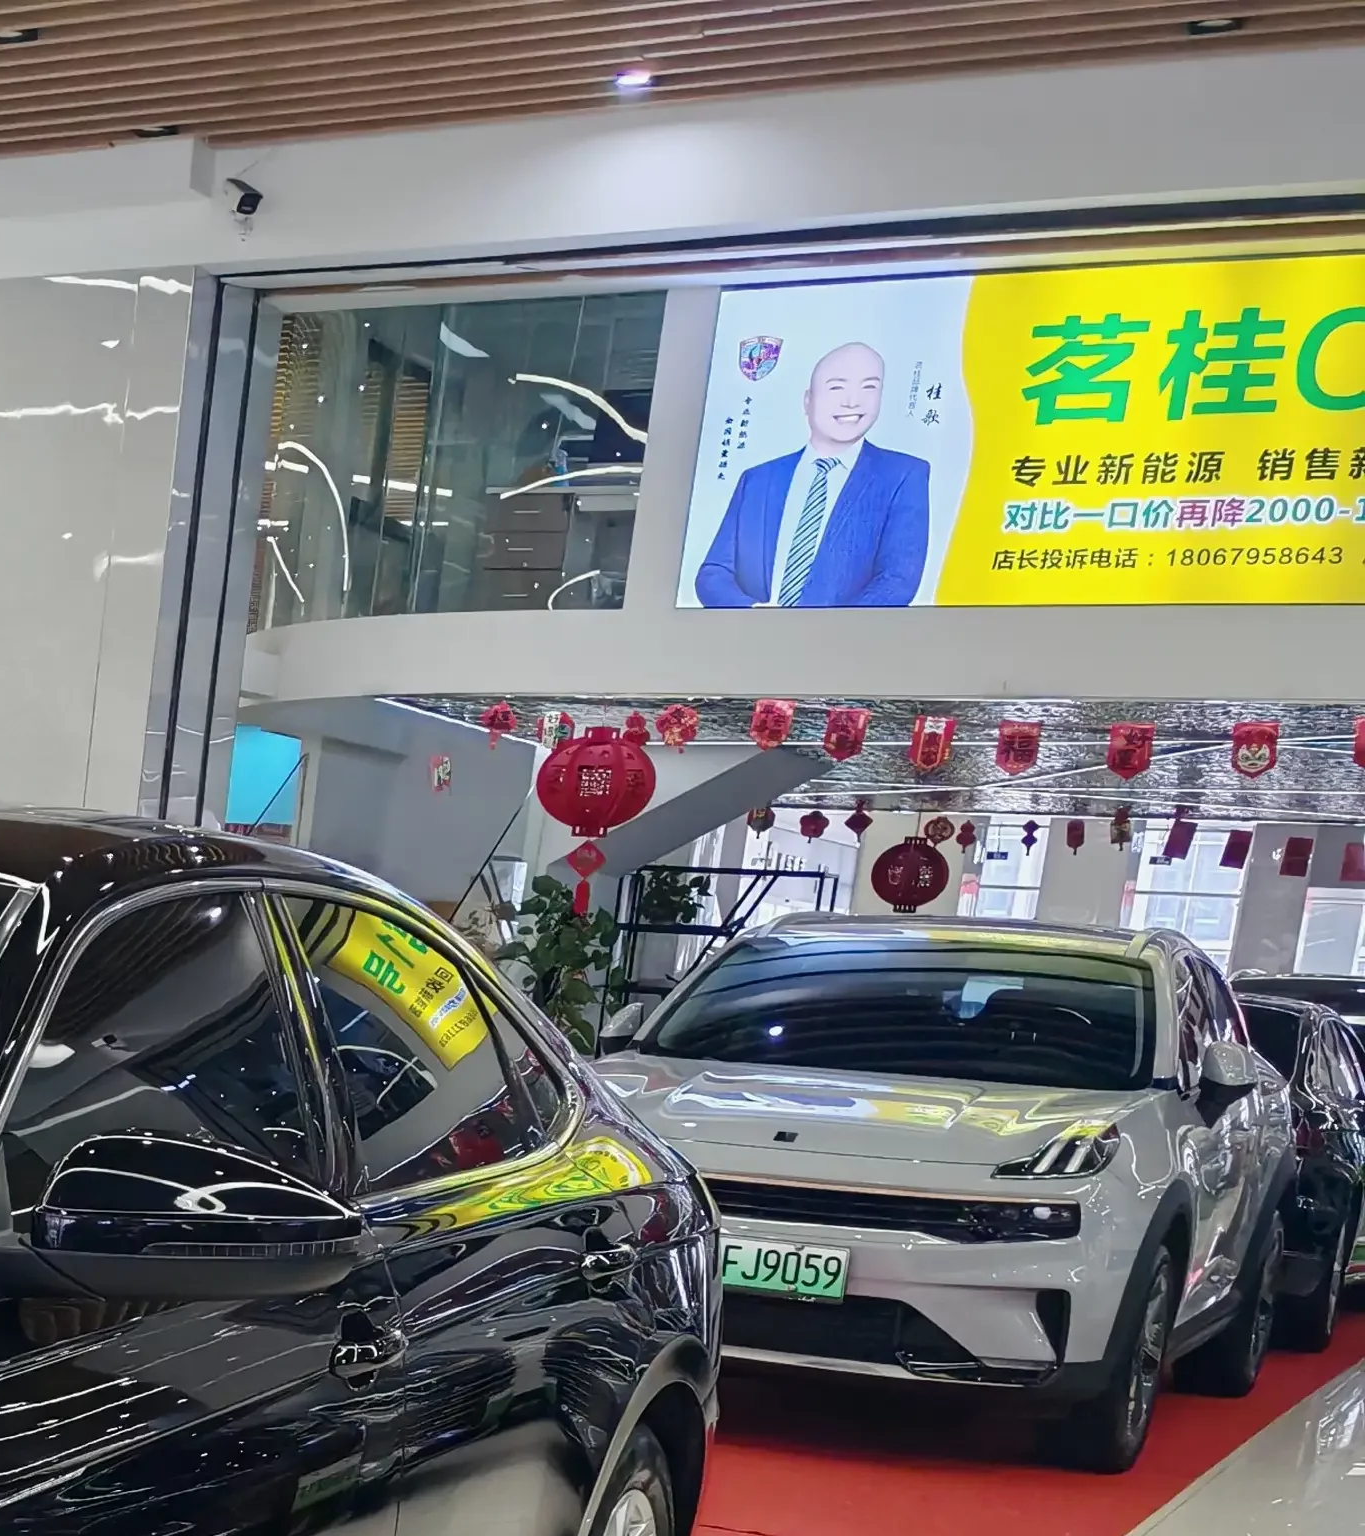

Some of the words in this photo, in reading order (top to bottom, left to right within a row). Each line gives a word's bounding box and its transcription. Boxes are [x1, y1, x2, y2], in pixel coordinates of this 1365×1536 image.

[1011, 450, 1225, 488] 专业新能源
[722, 1244, 842, 1290] FJ9059
